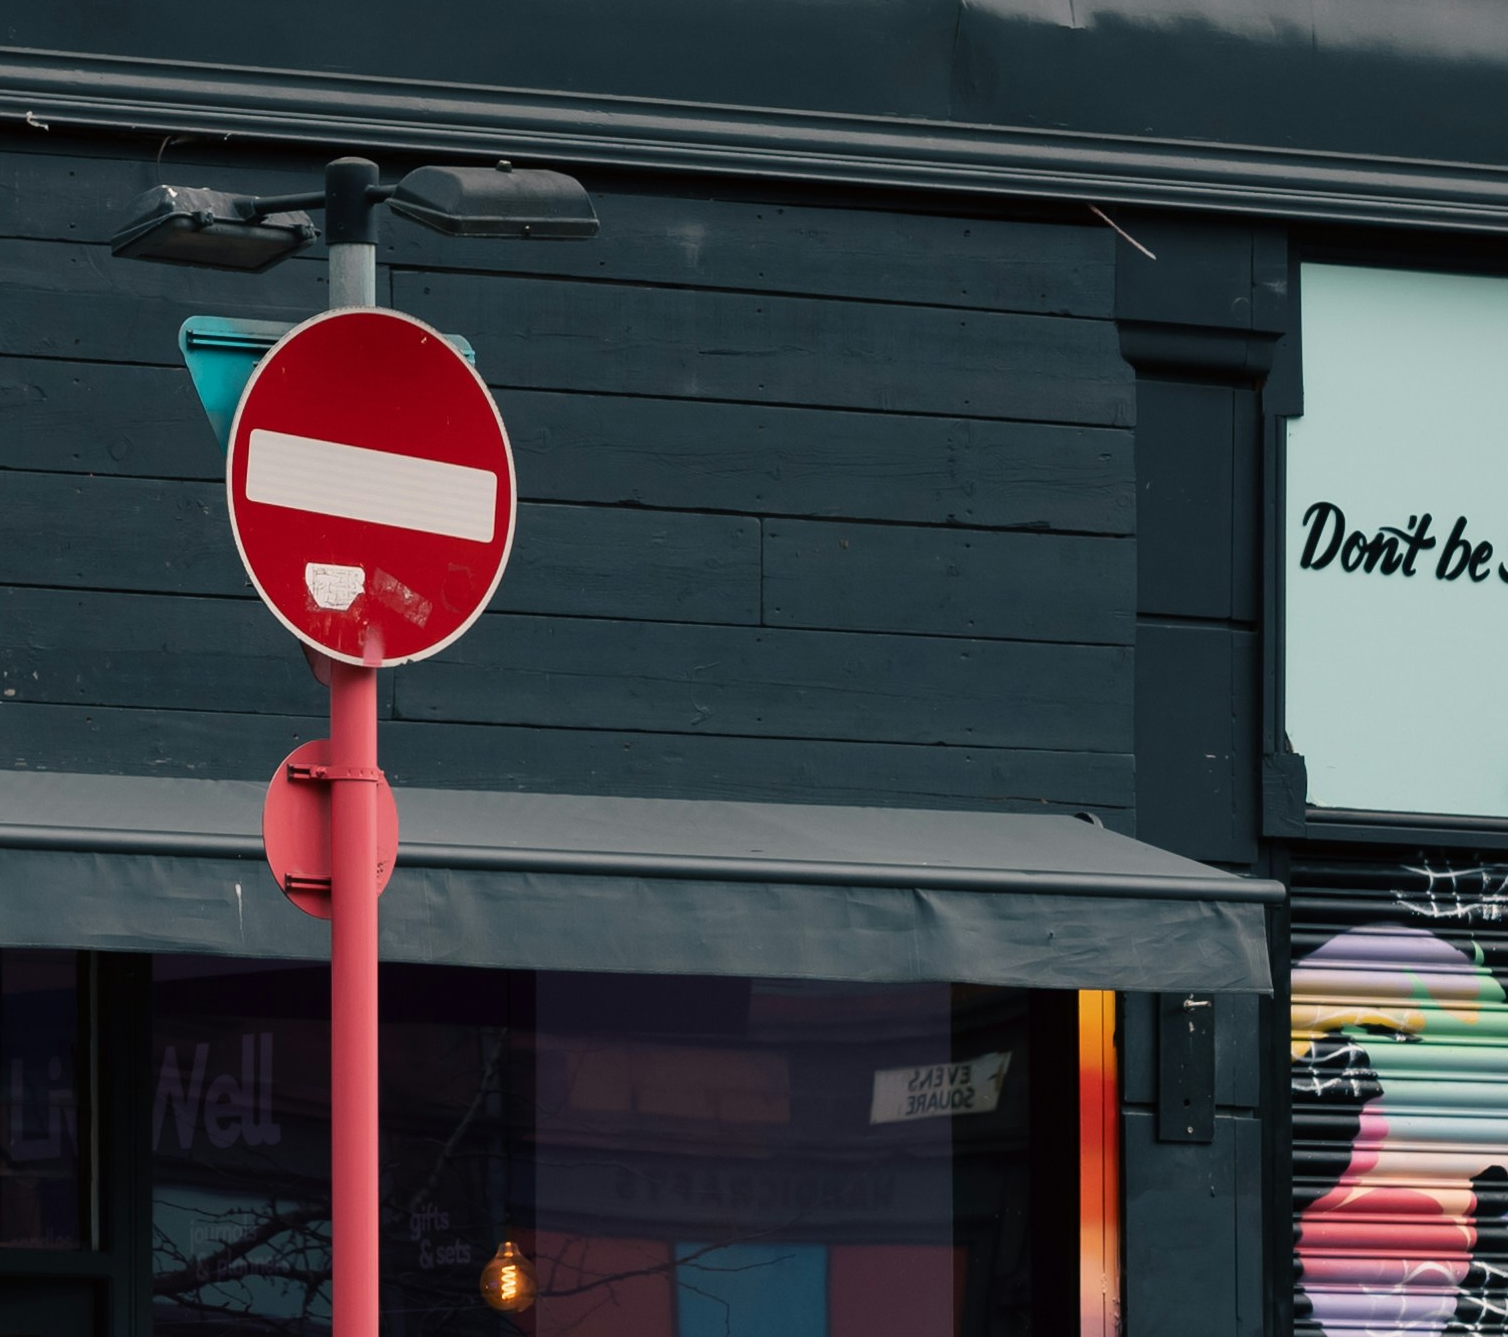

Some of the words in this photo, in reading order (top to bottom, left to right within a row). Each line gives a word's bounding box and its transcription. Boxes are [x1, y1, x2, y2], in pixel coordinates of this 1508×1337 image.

[1299, 500, 1437, 577] Don't
[1435, 515, 1494, 583] be
[410, 1204, 450, 1242] gifts
[436, 1238, 472, 1265] sets
